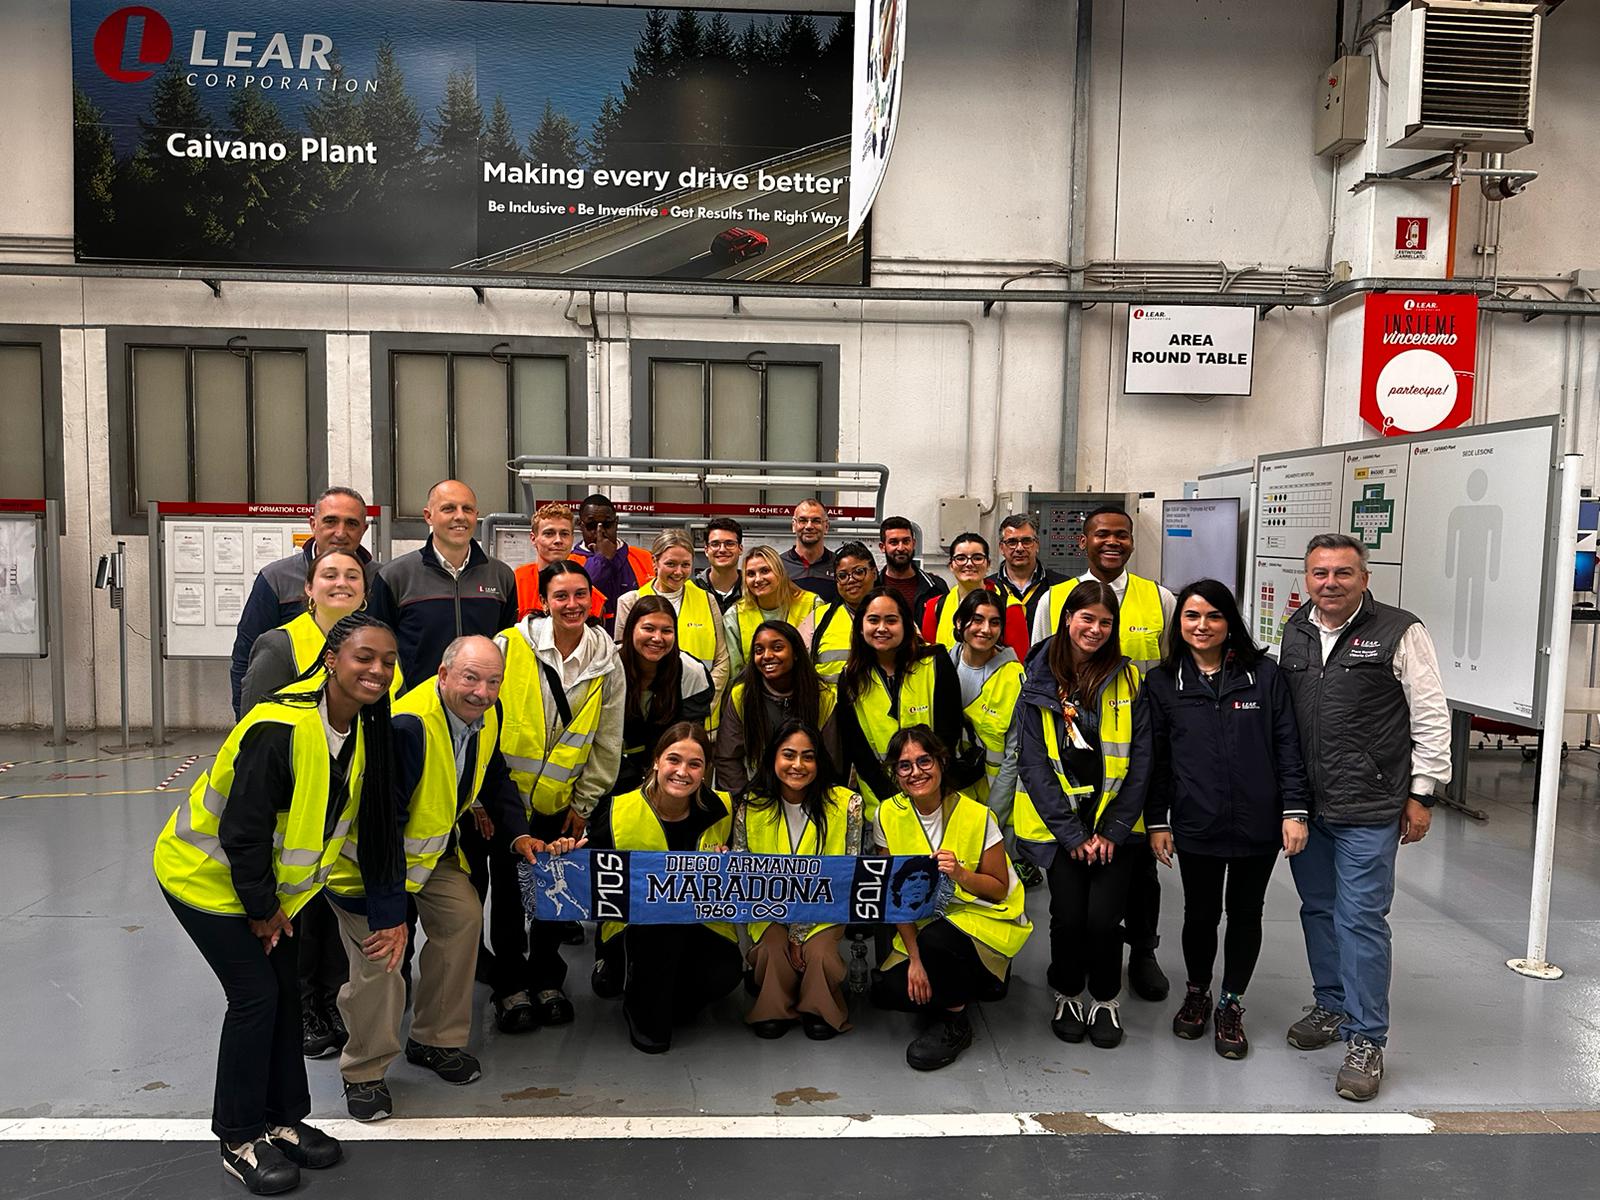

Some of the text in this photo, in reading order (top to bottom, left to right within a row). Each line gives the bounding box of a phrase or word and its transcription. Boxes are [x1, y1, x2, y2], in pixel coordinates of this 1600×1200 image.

[189, 29, 333, 71] LEAR
[186, 72, 380, 93] CORPORATION
[166, 132, 378, 165] Caivano Plant
[483, 161, 843, 194] Making every drive better
[488, 200, 842, 227] Be Inclusive Be Inventive Get Results The Right Way
[1169, 334, 1214, 346] AREA
[1383, 331, 1458, 345] vinceremo
[1132, 351, 1248, 365] ROUND TABLE
[1388, 385, 1449, 398] partecipa!
[666, 855, 821, 875] DIEGO ARMANDO
[646, 873, 835, 904] MARADONA
[695, 903, 738, 919] 1960
